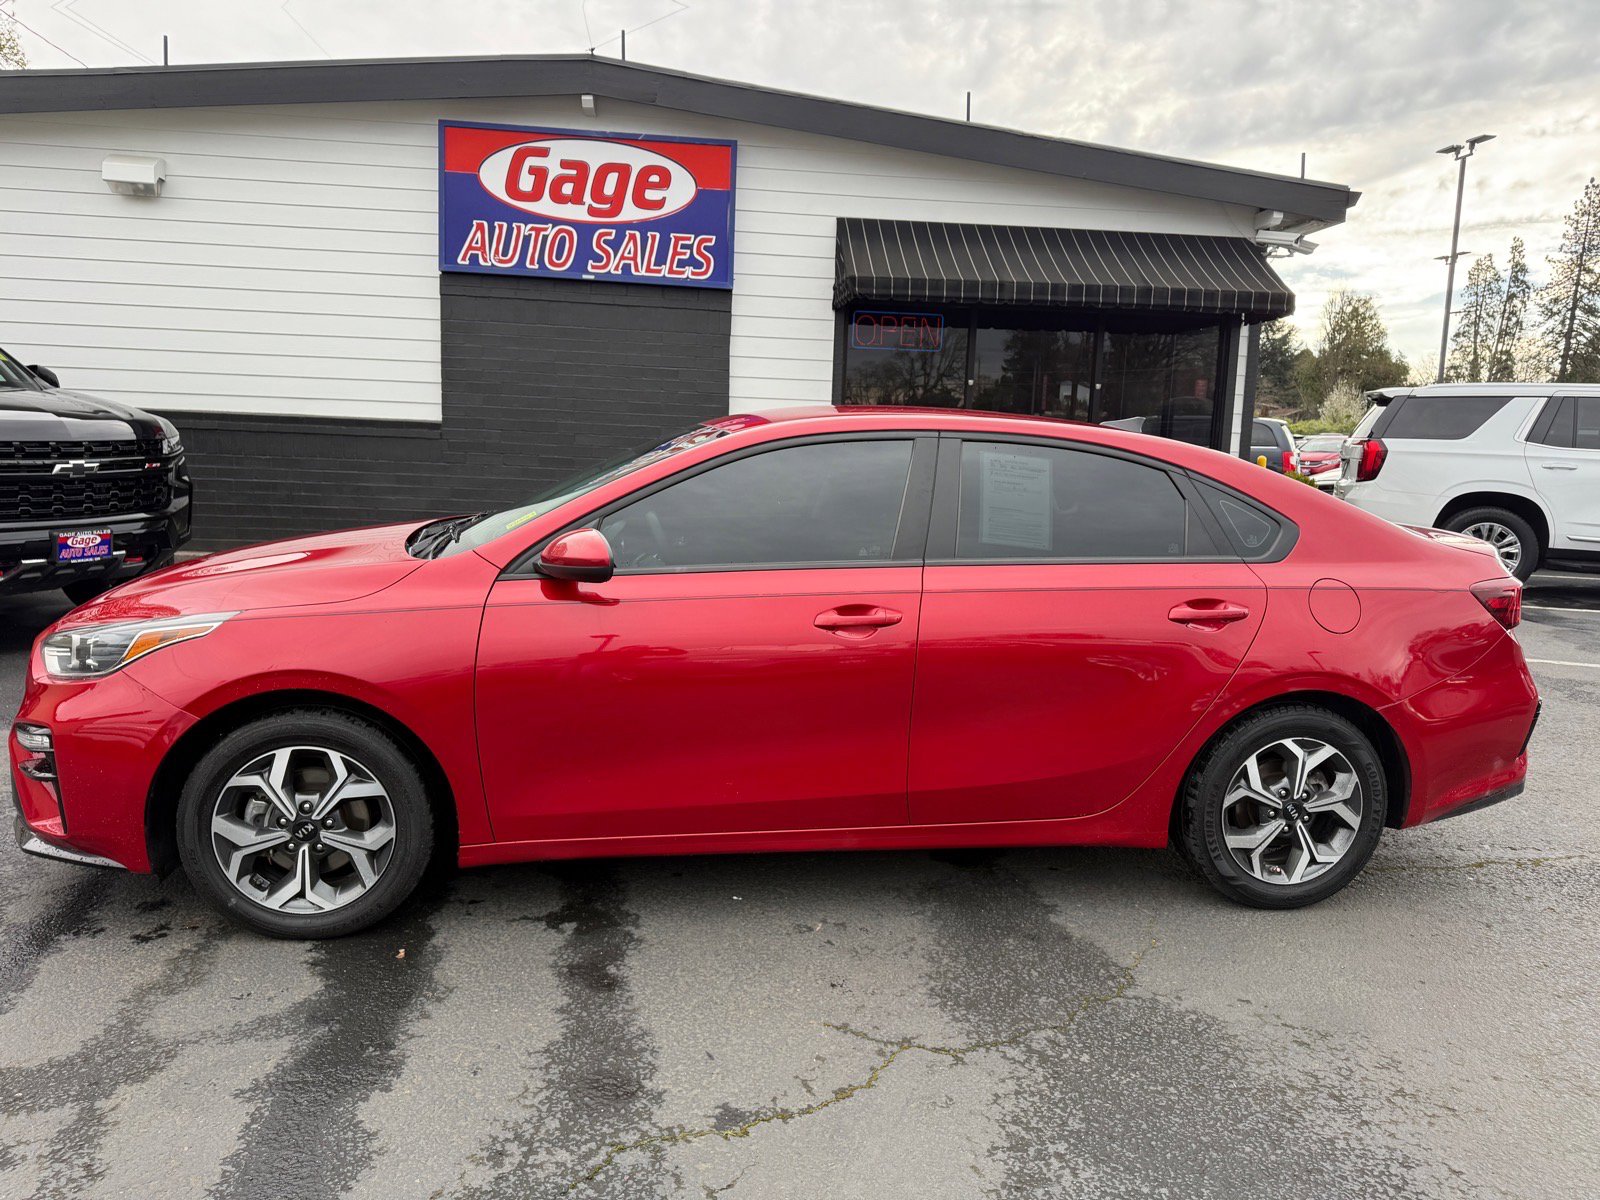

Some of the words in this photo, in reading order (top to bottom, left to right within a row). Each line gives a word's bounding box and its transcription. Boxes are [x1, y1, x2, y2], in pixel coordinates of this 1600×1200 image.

[504, 145, 673, 219] Gage
[457, 219, 578, 272] AUTO
[587, 228, 717, 280] SALES
[855, 314, 942, 347] OPEN
[71, 536, 97, 546] Gage
[59, 547, 83, 559] AUTO
[84, 545, 109, 556] SALES
[1286, 803, 1299, 820] KIA
[295, 823, 314, 838] KIA
